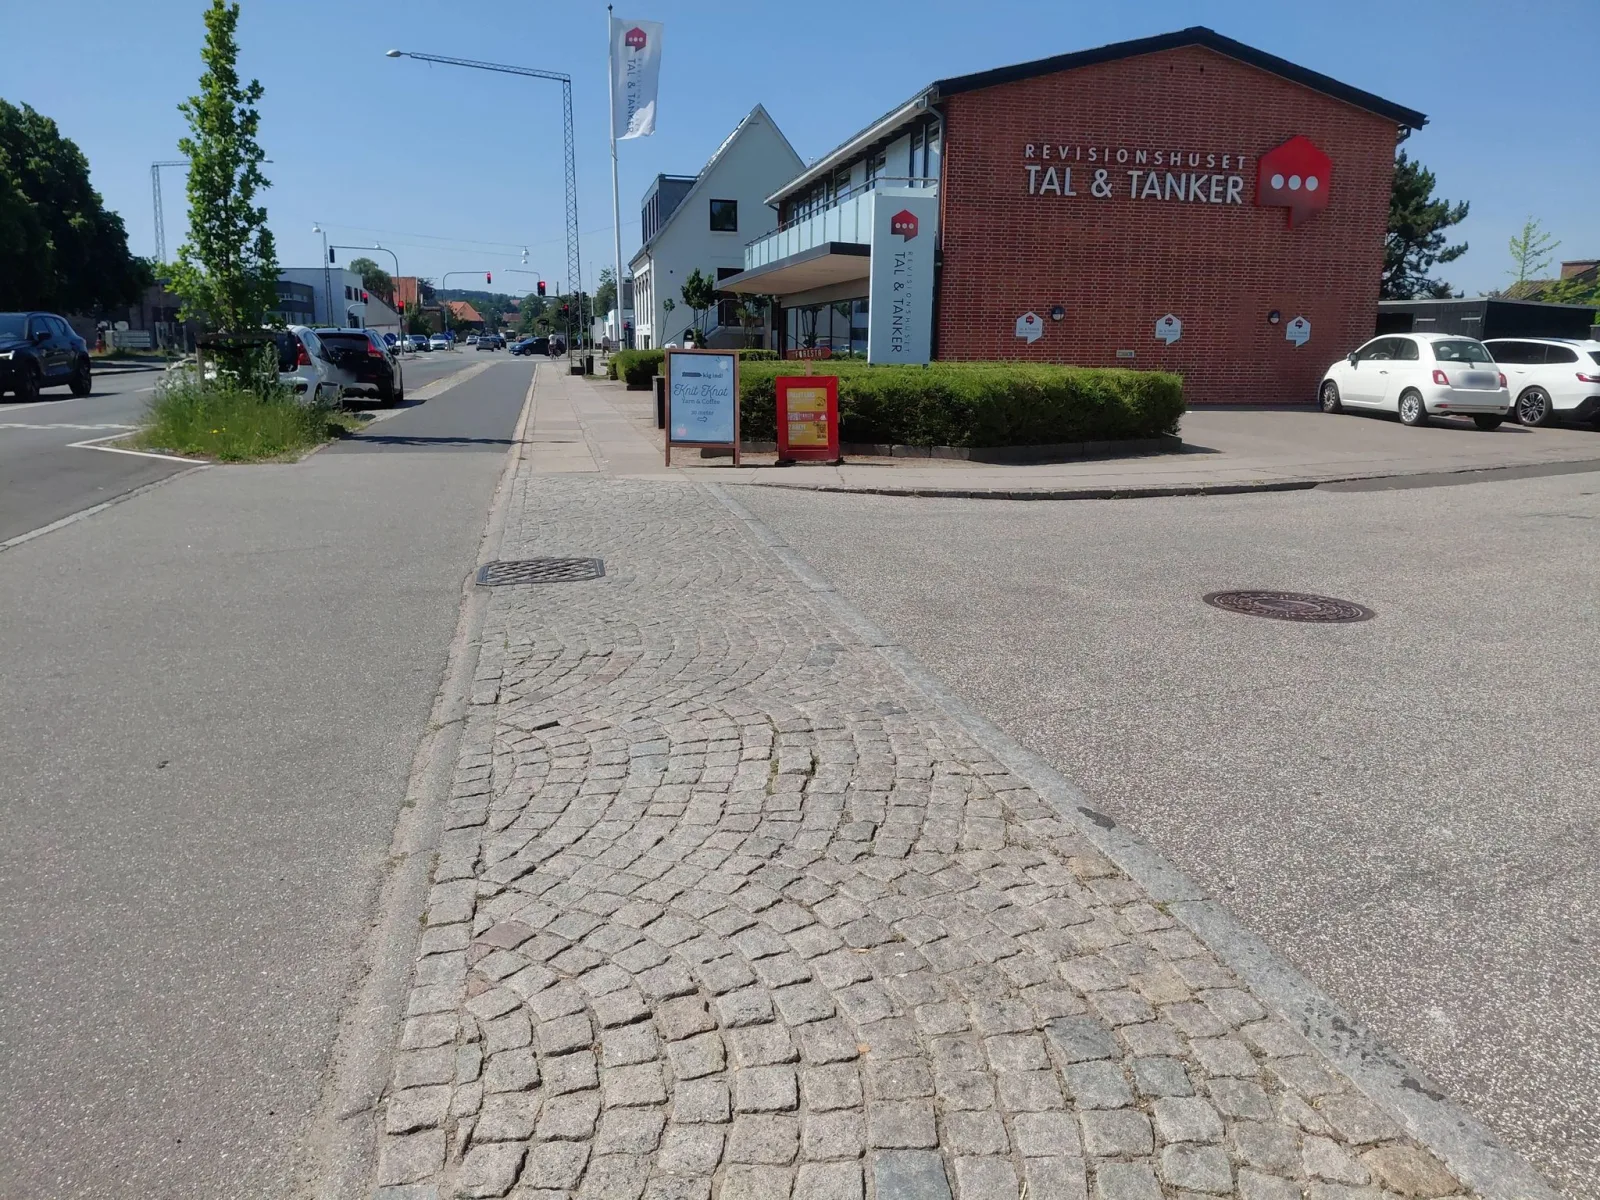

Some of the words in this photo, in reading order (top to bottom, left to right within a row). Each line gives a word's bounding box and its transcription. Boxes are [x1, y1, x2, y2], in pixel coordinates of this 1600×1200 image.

[627, 59, 636, 76] TAL
[627, 81, 636, 89] &
[1025, 144, 1246, 170] REVISIONSHUSET
[1025, 165, 1077, 197] TAL
[1091, 168, 1113, 198] &
[1127, 170, 1244, 204] TANKER
[893, 252, 906, 275] TAL
[893, 281, 905, 292] &
[904, 251, 913, 353] REVISIONSHUSET
[891, 298, 904, 353] TANKER
[674, 384, 698, 400] Knit
[701, 384, 728, 399] Knot
